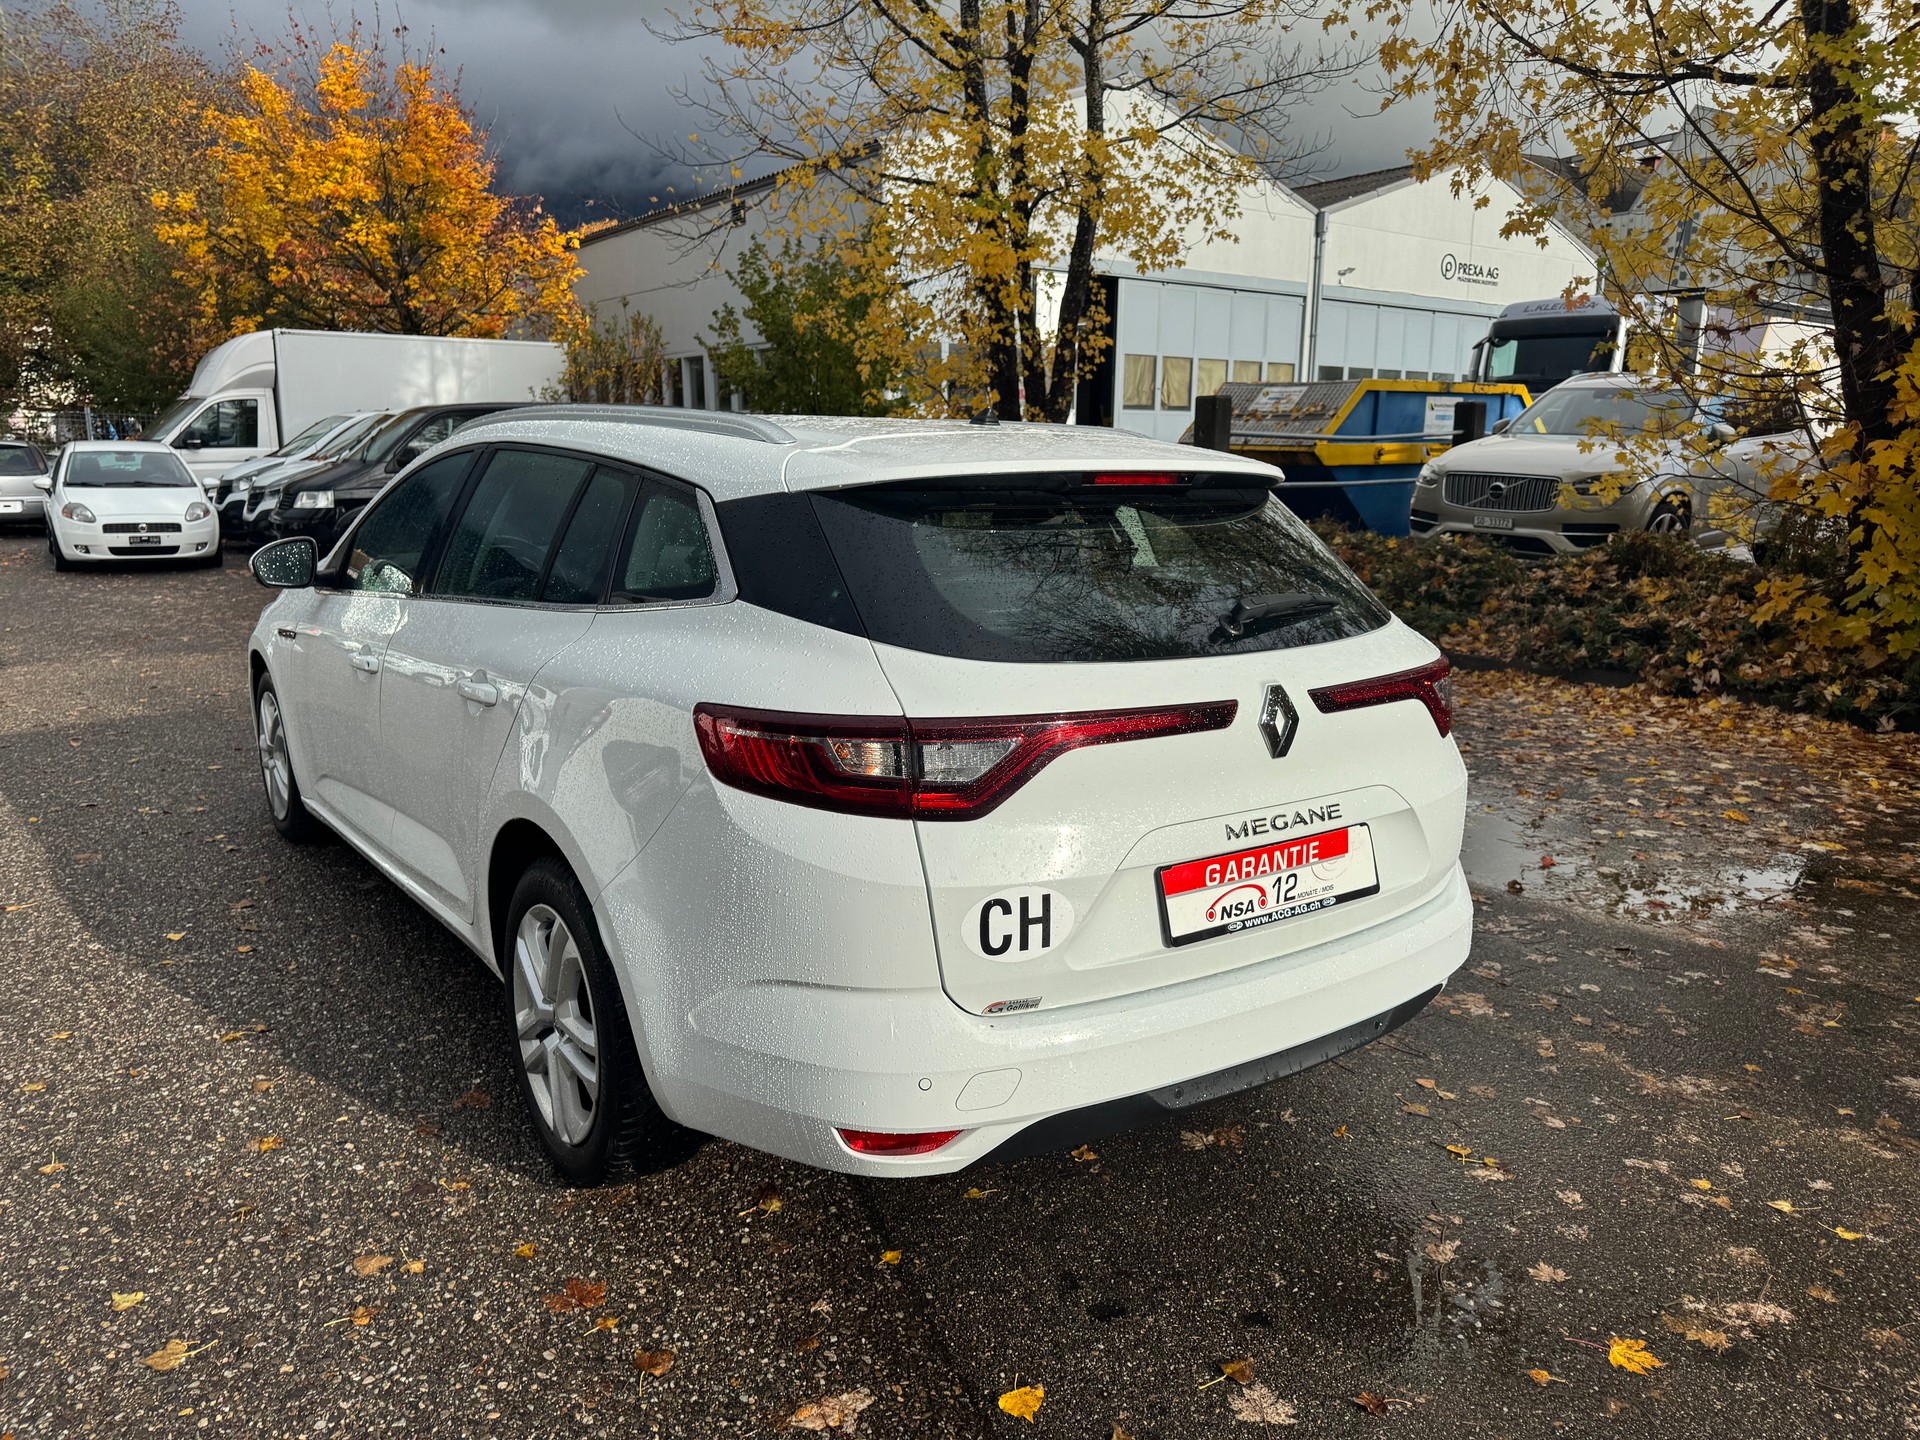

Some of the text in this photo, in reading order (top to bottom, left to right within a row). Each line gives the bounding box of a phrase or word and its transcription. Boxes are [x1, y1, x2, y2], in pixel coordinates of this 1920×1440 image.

[1457, 262, 1499, 280] PREXA AG
[1225, 803, 1343, 840] MEGANE
[1205, 841, 1320, 887] GARANTIE
[1272, 873, 1298, 904] 12
[1297, 887, 1318, 899] MONATE
[1322, 884, 1334, 893] MOIS
[979, 893, 1051, 956] CH
[1220, 899, 1255, 921] NSA
[1244, 901, 1321, 928] www.ACG-AG.ch
